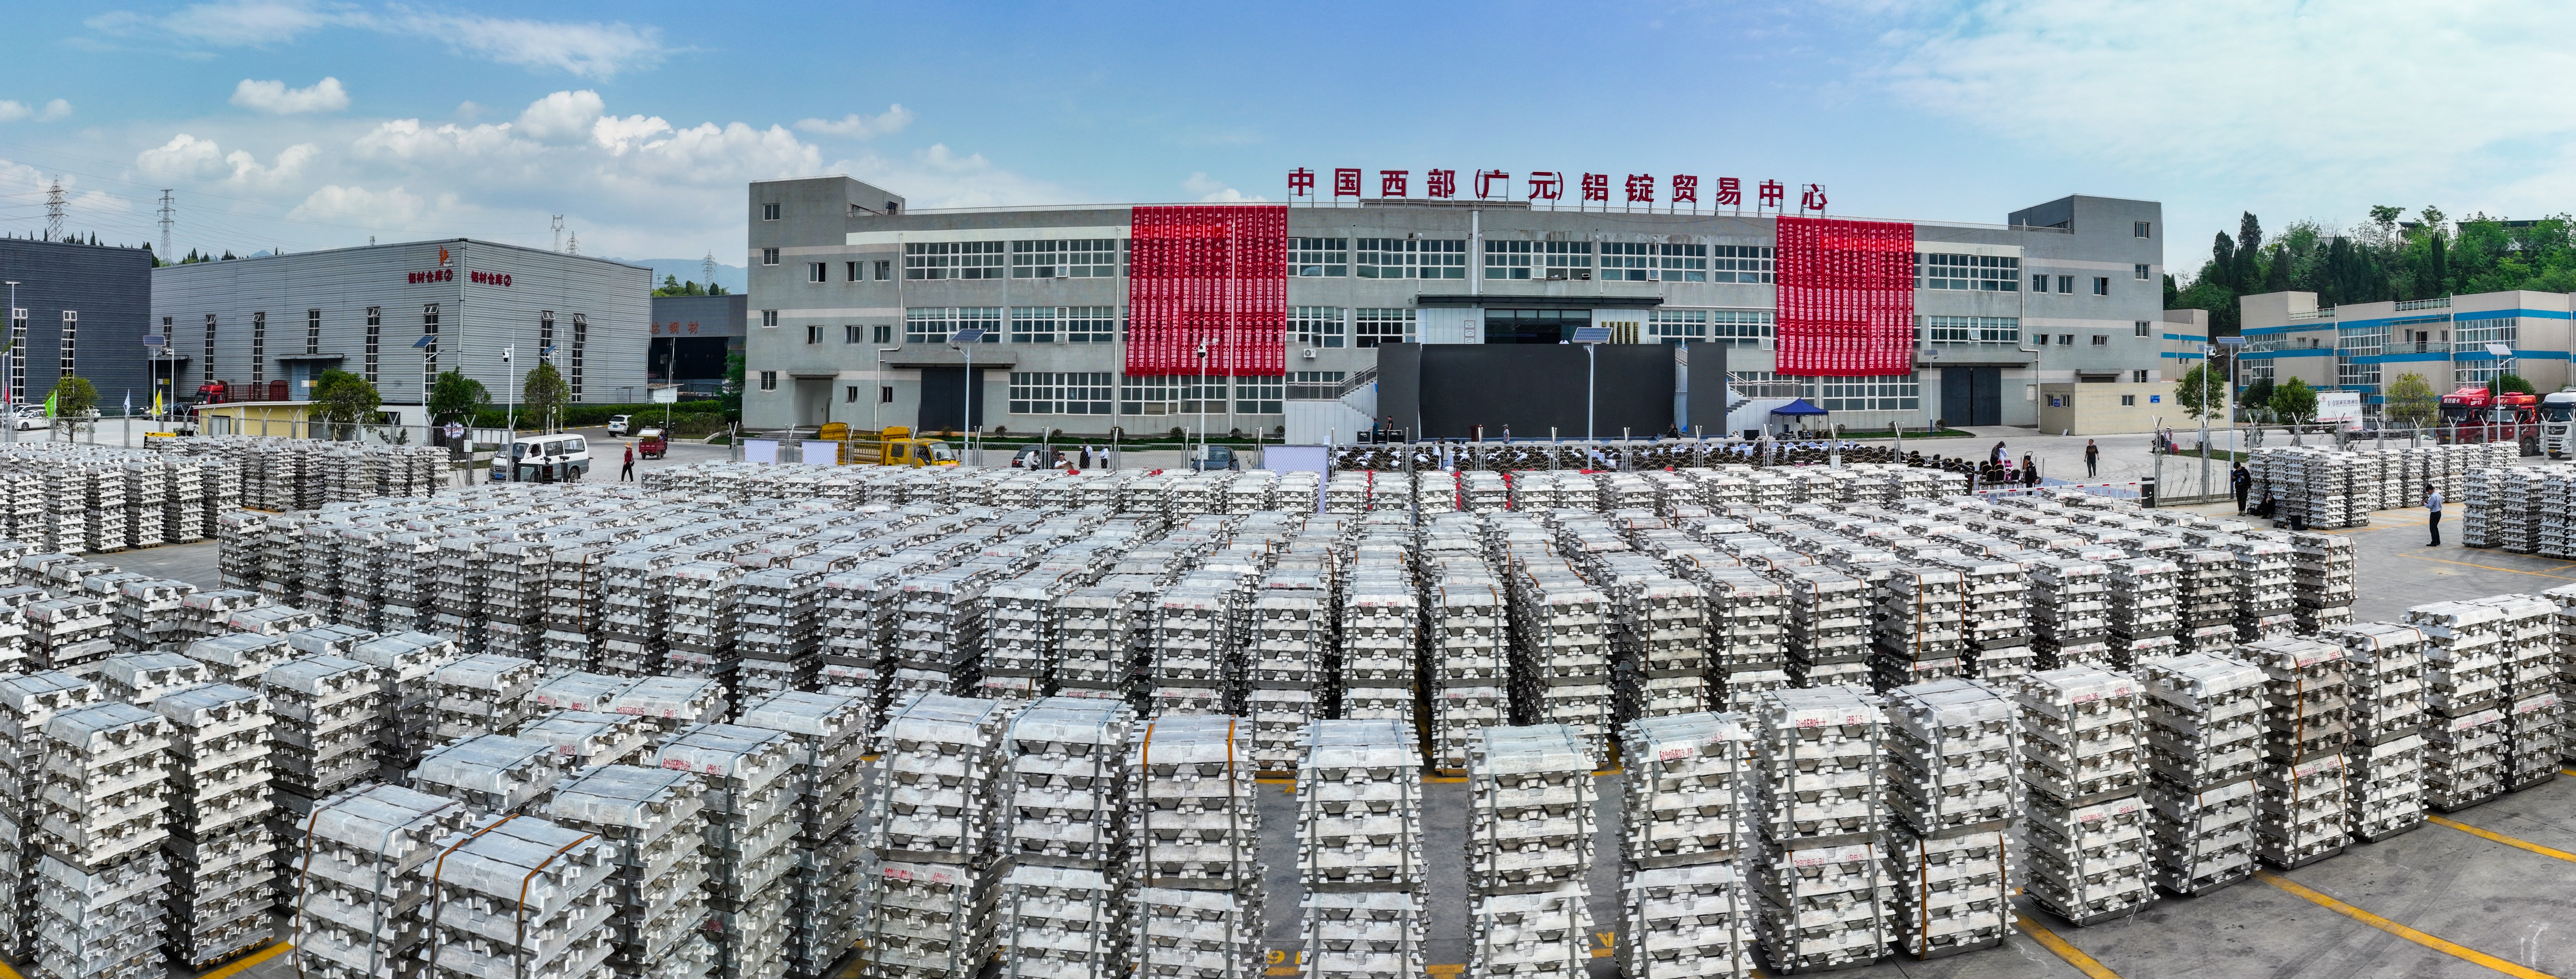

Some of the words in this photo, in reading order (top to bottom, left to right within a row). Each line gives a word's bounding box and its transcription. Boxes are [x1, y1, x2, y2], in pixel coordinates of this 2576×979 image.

[1288, 167, 1828, 210] 中国西部（广元）铝锭贸易中心
[2115, 688, 2130, 696] 1192.5
